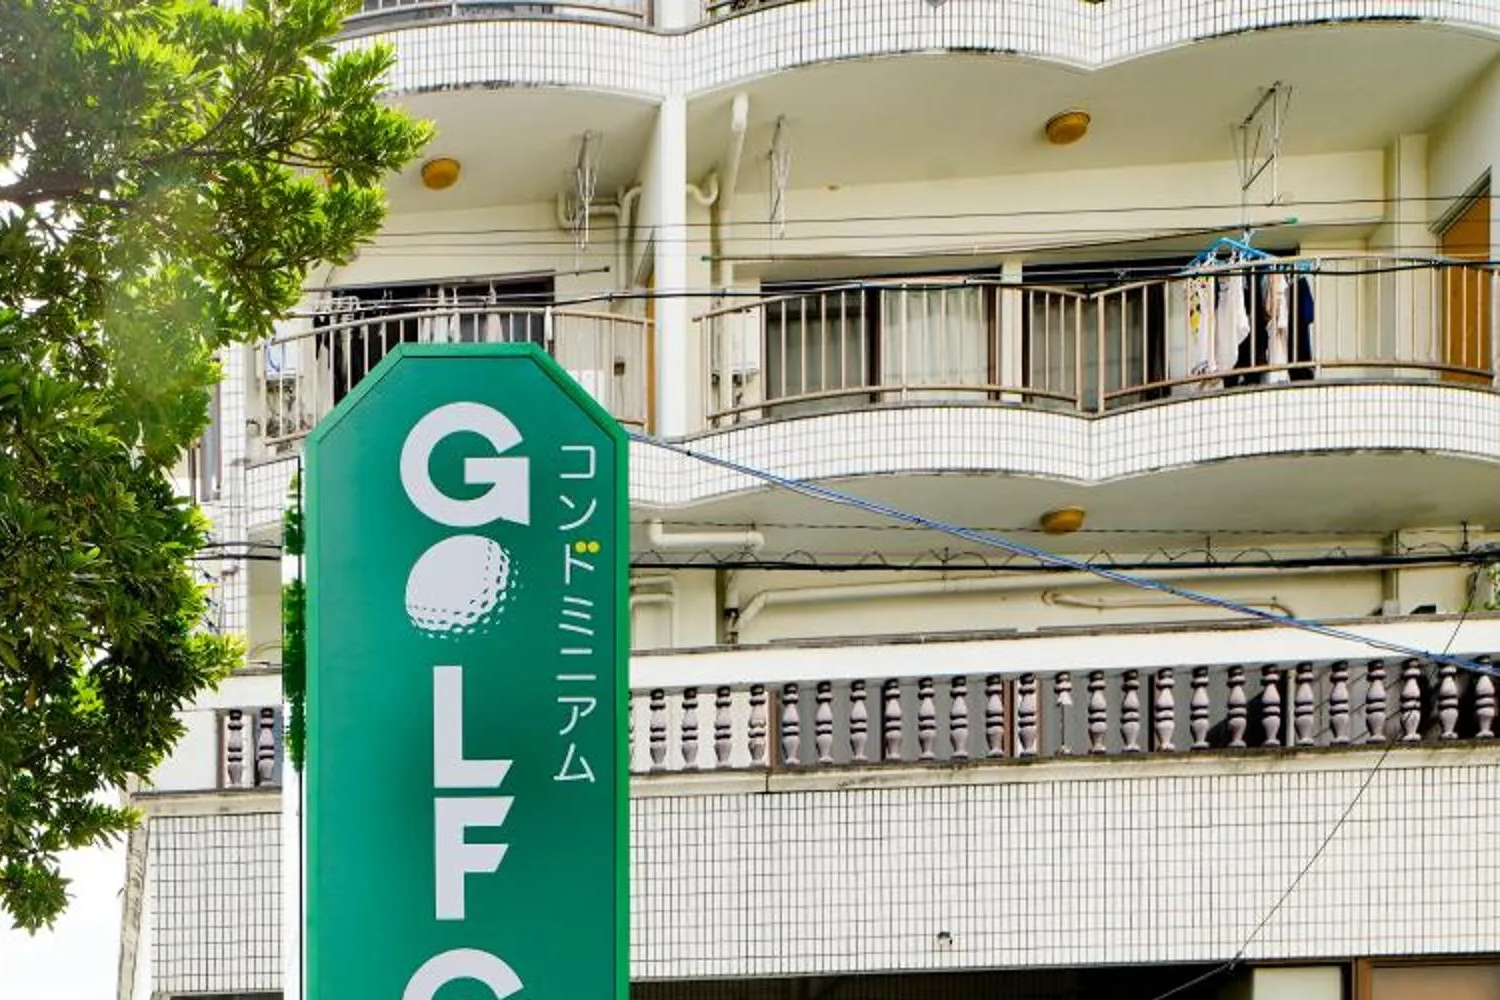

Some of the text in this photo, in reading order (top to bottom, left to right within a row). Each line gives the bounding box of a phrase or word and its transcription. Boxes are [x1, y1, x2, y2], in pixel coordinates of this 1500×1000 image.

[553, 445, 600, 783] コンドミニアム
